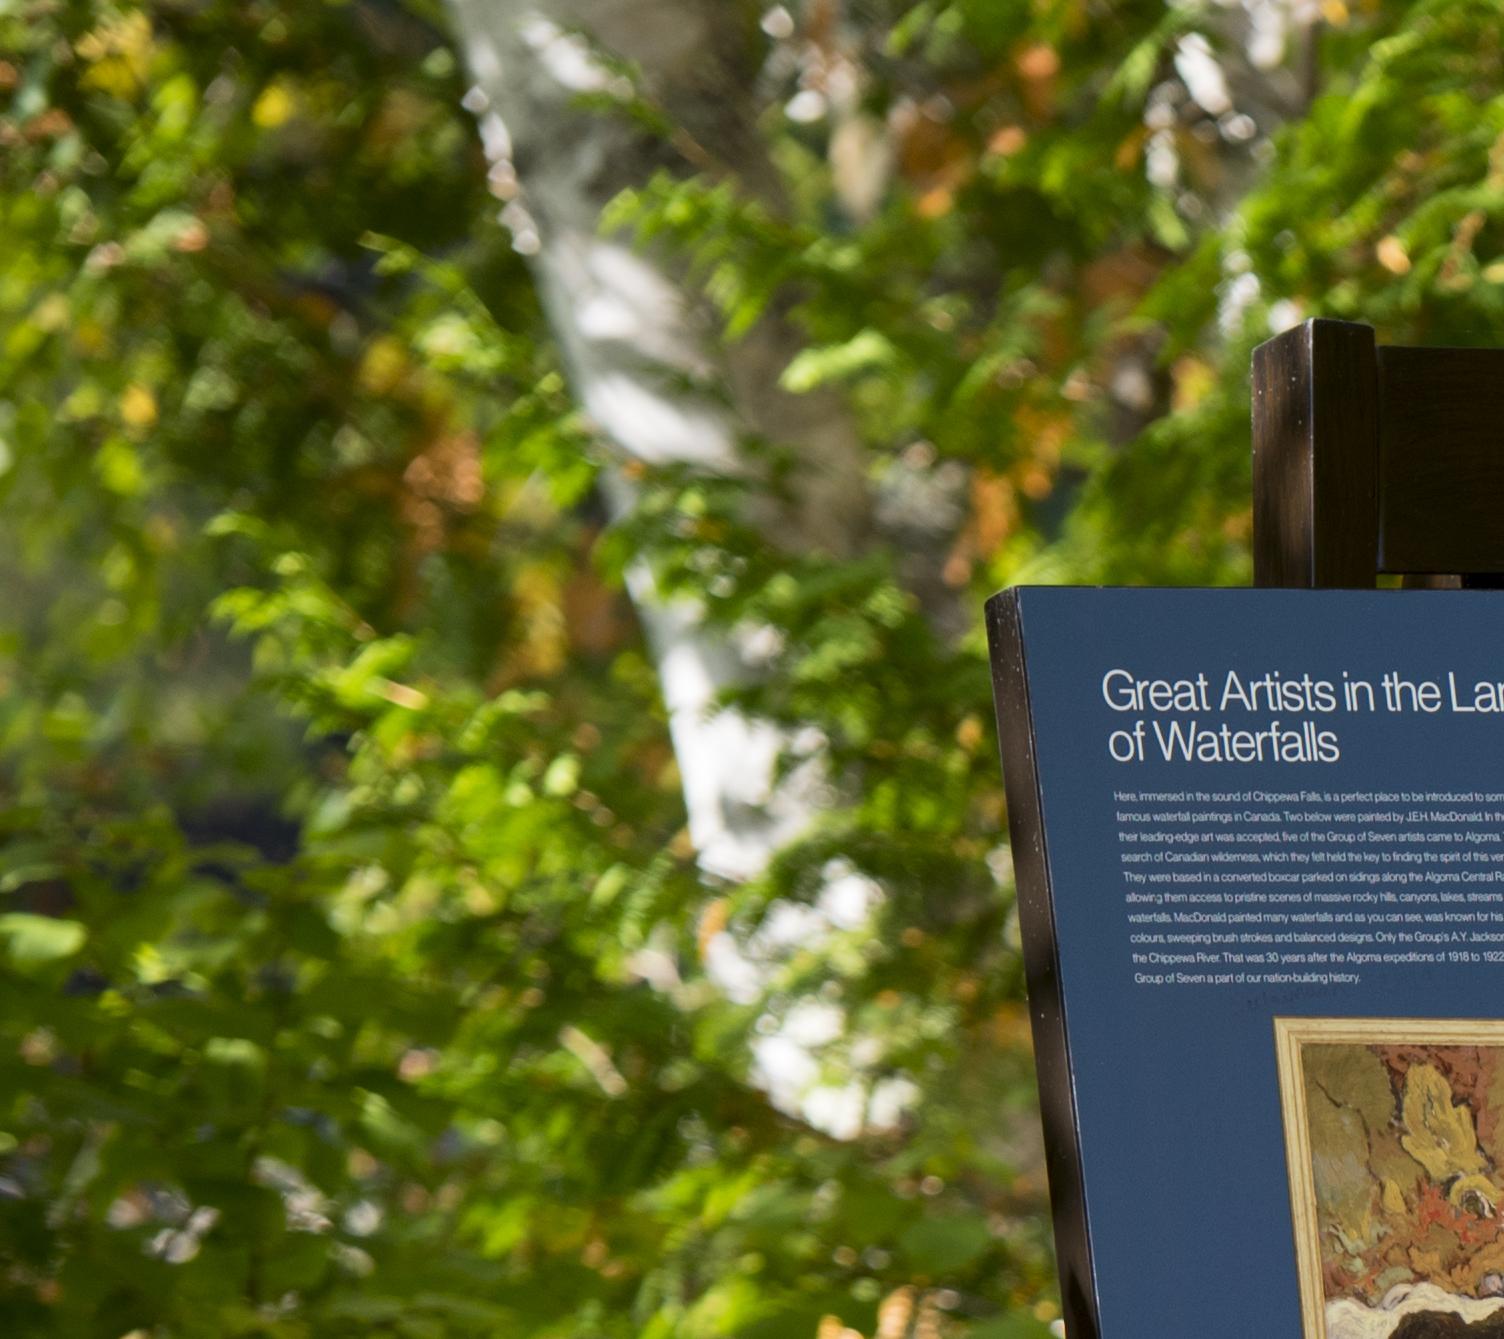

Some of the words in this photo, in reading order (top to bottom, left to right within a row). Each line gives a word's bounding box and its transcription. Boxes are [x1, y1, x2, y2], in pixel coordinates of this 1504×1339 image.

[1102, 669, 1211, 711] Great
[1220, 671, 1336, 712] Artists
[1343, 671, 1375, 711] in
[1383, 671, 1441, 712] the
[1109, 721, 1145, 761] of
[1153, 721, 1340, 762] Waterfalls
[1114, 791, 1138, 802] Here,
[1139, 791, 1185, 802] immersed
[1186, 793, 1194, 801] in
[1195, 792, 1210, 802] the
[1212, 792, 1241, 802] sound
[1242, 791, 1251, 802] of
[1253, 791, 1299, 803] Chippewa
[1300, 791, 1323, 802] Falls,
[1324, 793, 1332, 802] is
[1333, 793, 1340, 802] a
[1341, 791, 1373, 803] perfect
[1374, 792, 1400, 803] place
[1401, 792, 1411, 802] to
[1411, 792, 1424, 802] be
[1425, 792, 1474, 802] introduced
[1474, 792, 1484, 802] to
[1116, 811, 1151, 822] famous
[1152, 811, 1191, 822] waterfall
[1192, 812, 1233, 824] paintings
[1234, 813, 1242, 821] in
[1243, 811, 1282, 822] Canada.
[1283, 811, 1303, 822] Two
[1304, 812, 1332, 822] below
[1333, 813, 1356, 822] were
[1357, 812, 1392, 823] painted
[1392, 812, 1404, 824] by
[1406, 811, 1429, 822] J.E.H.
[1430, 811, 1483, 822] MacDonald.
[1134, 972, 1164, 985] Group
[1165, 973, 1175, 983] of
[1176, 972, 1206, 983] Seven
[1207, 975, 1214, 983] a
[1215, 973, 1234, 985] part
[1235, 972, 1245, 983] of
[1246, 975, 1262, 983] our
[1263, 972, 1328, 985] nation-building
[1329, 972, 1361, 984] history.
